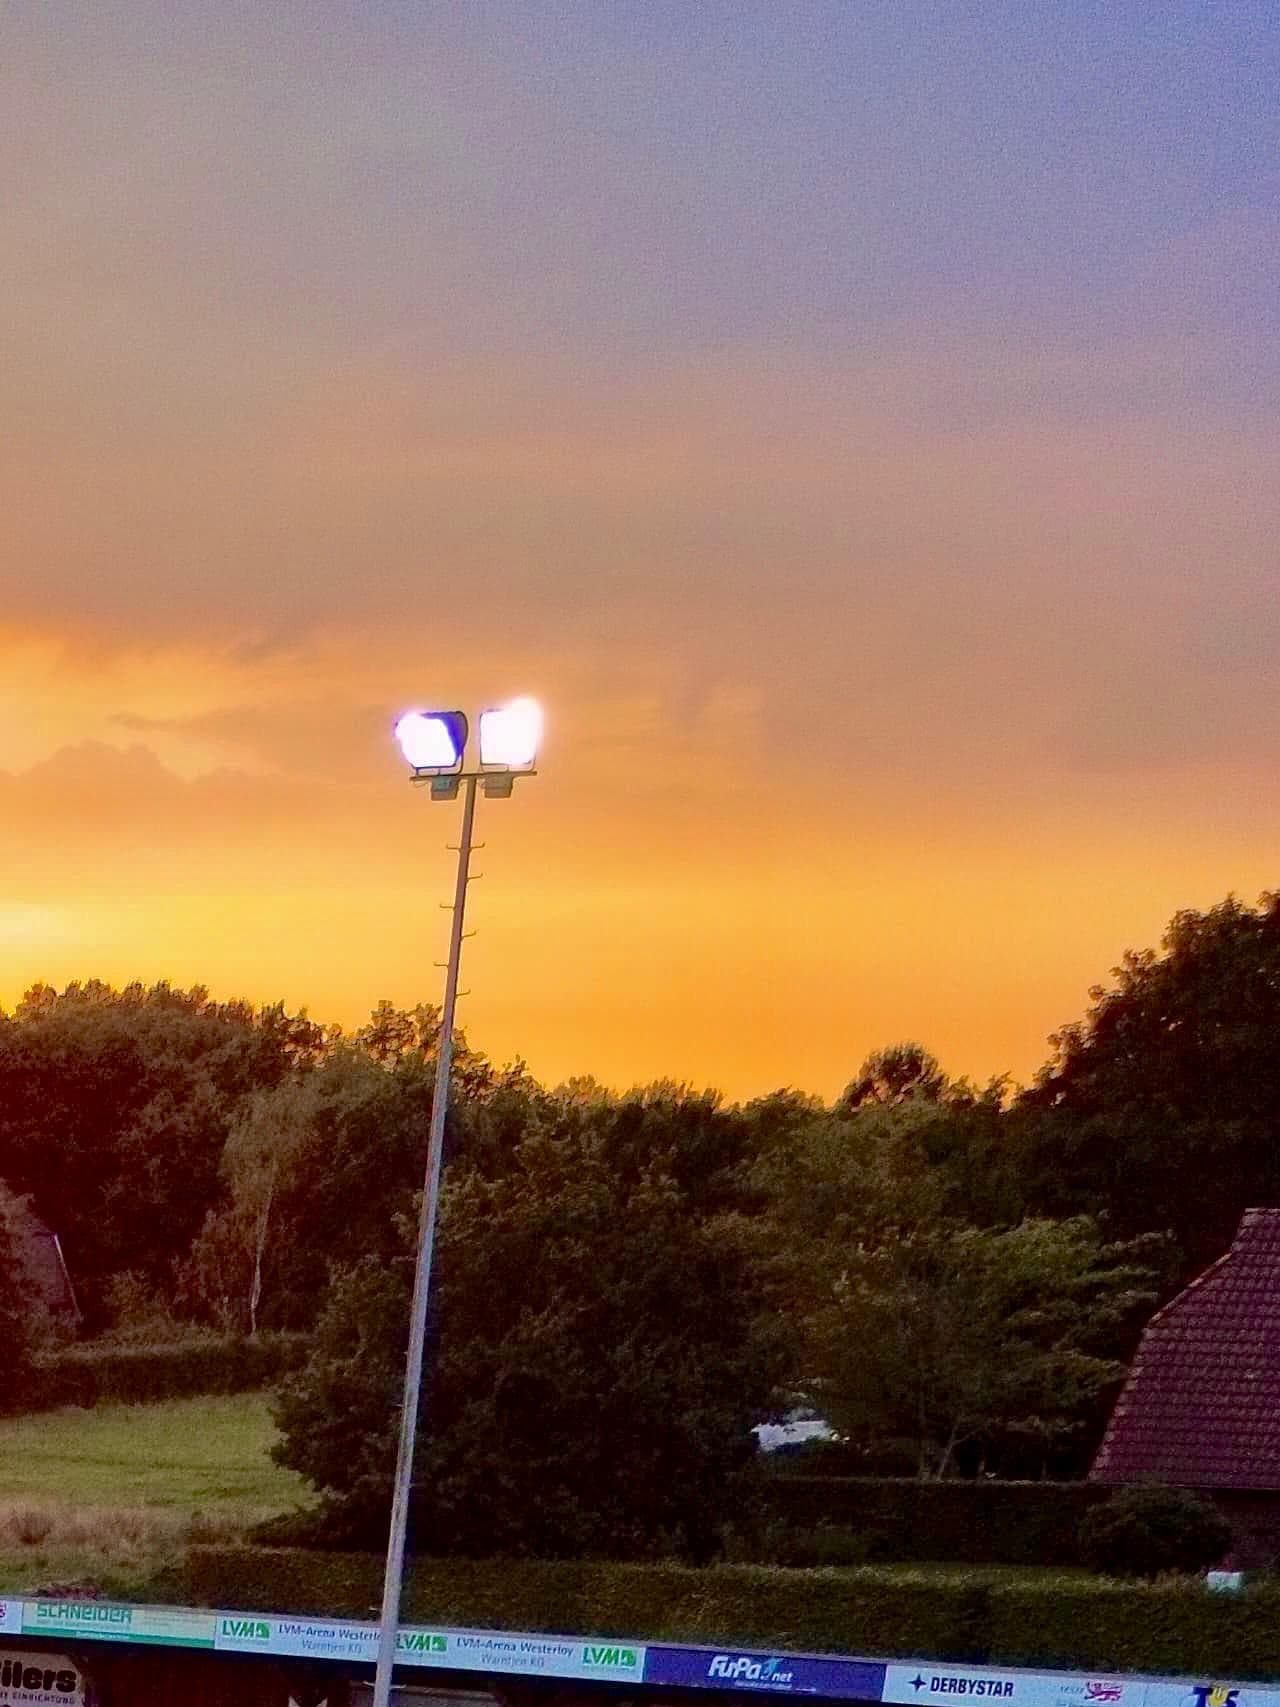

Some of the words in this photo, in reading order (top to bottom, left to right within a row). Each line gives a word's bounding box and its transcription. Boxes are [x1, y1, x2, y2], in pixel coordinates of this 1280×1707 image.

[37, 1603, 133, 1624] SCHNEIDER
[222, 1620, 255, 1638] LVM
[279, 1624, 336, 1638] LVM-Arena
[339, 1629, 383, 1641] Westerl
[396, 1632, 431, 1651] LVM
[456, 1637, 517, 1652] LVM-Arena
[520, 1642, 574, 1657] Westerloy
[582, 1646, 621, 1664] LVM
[930, 1676, 1014, 1697] DERBYSTAR
